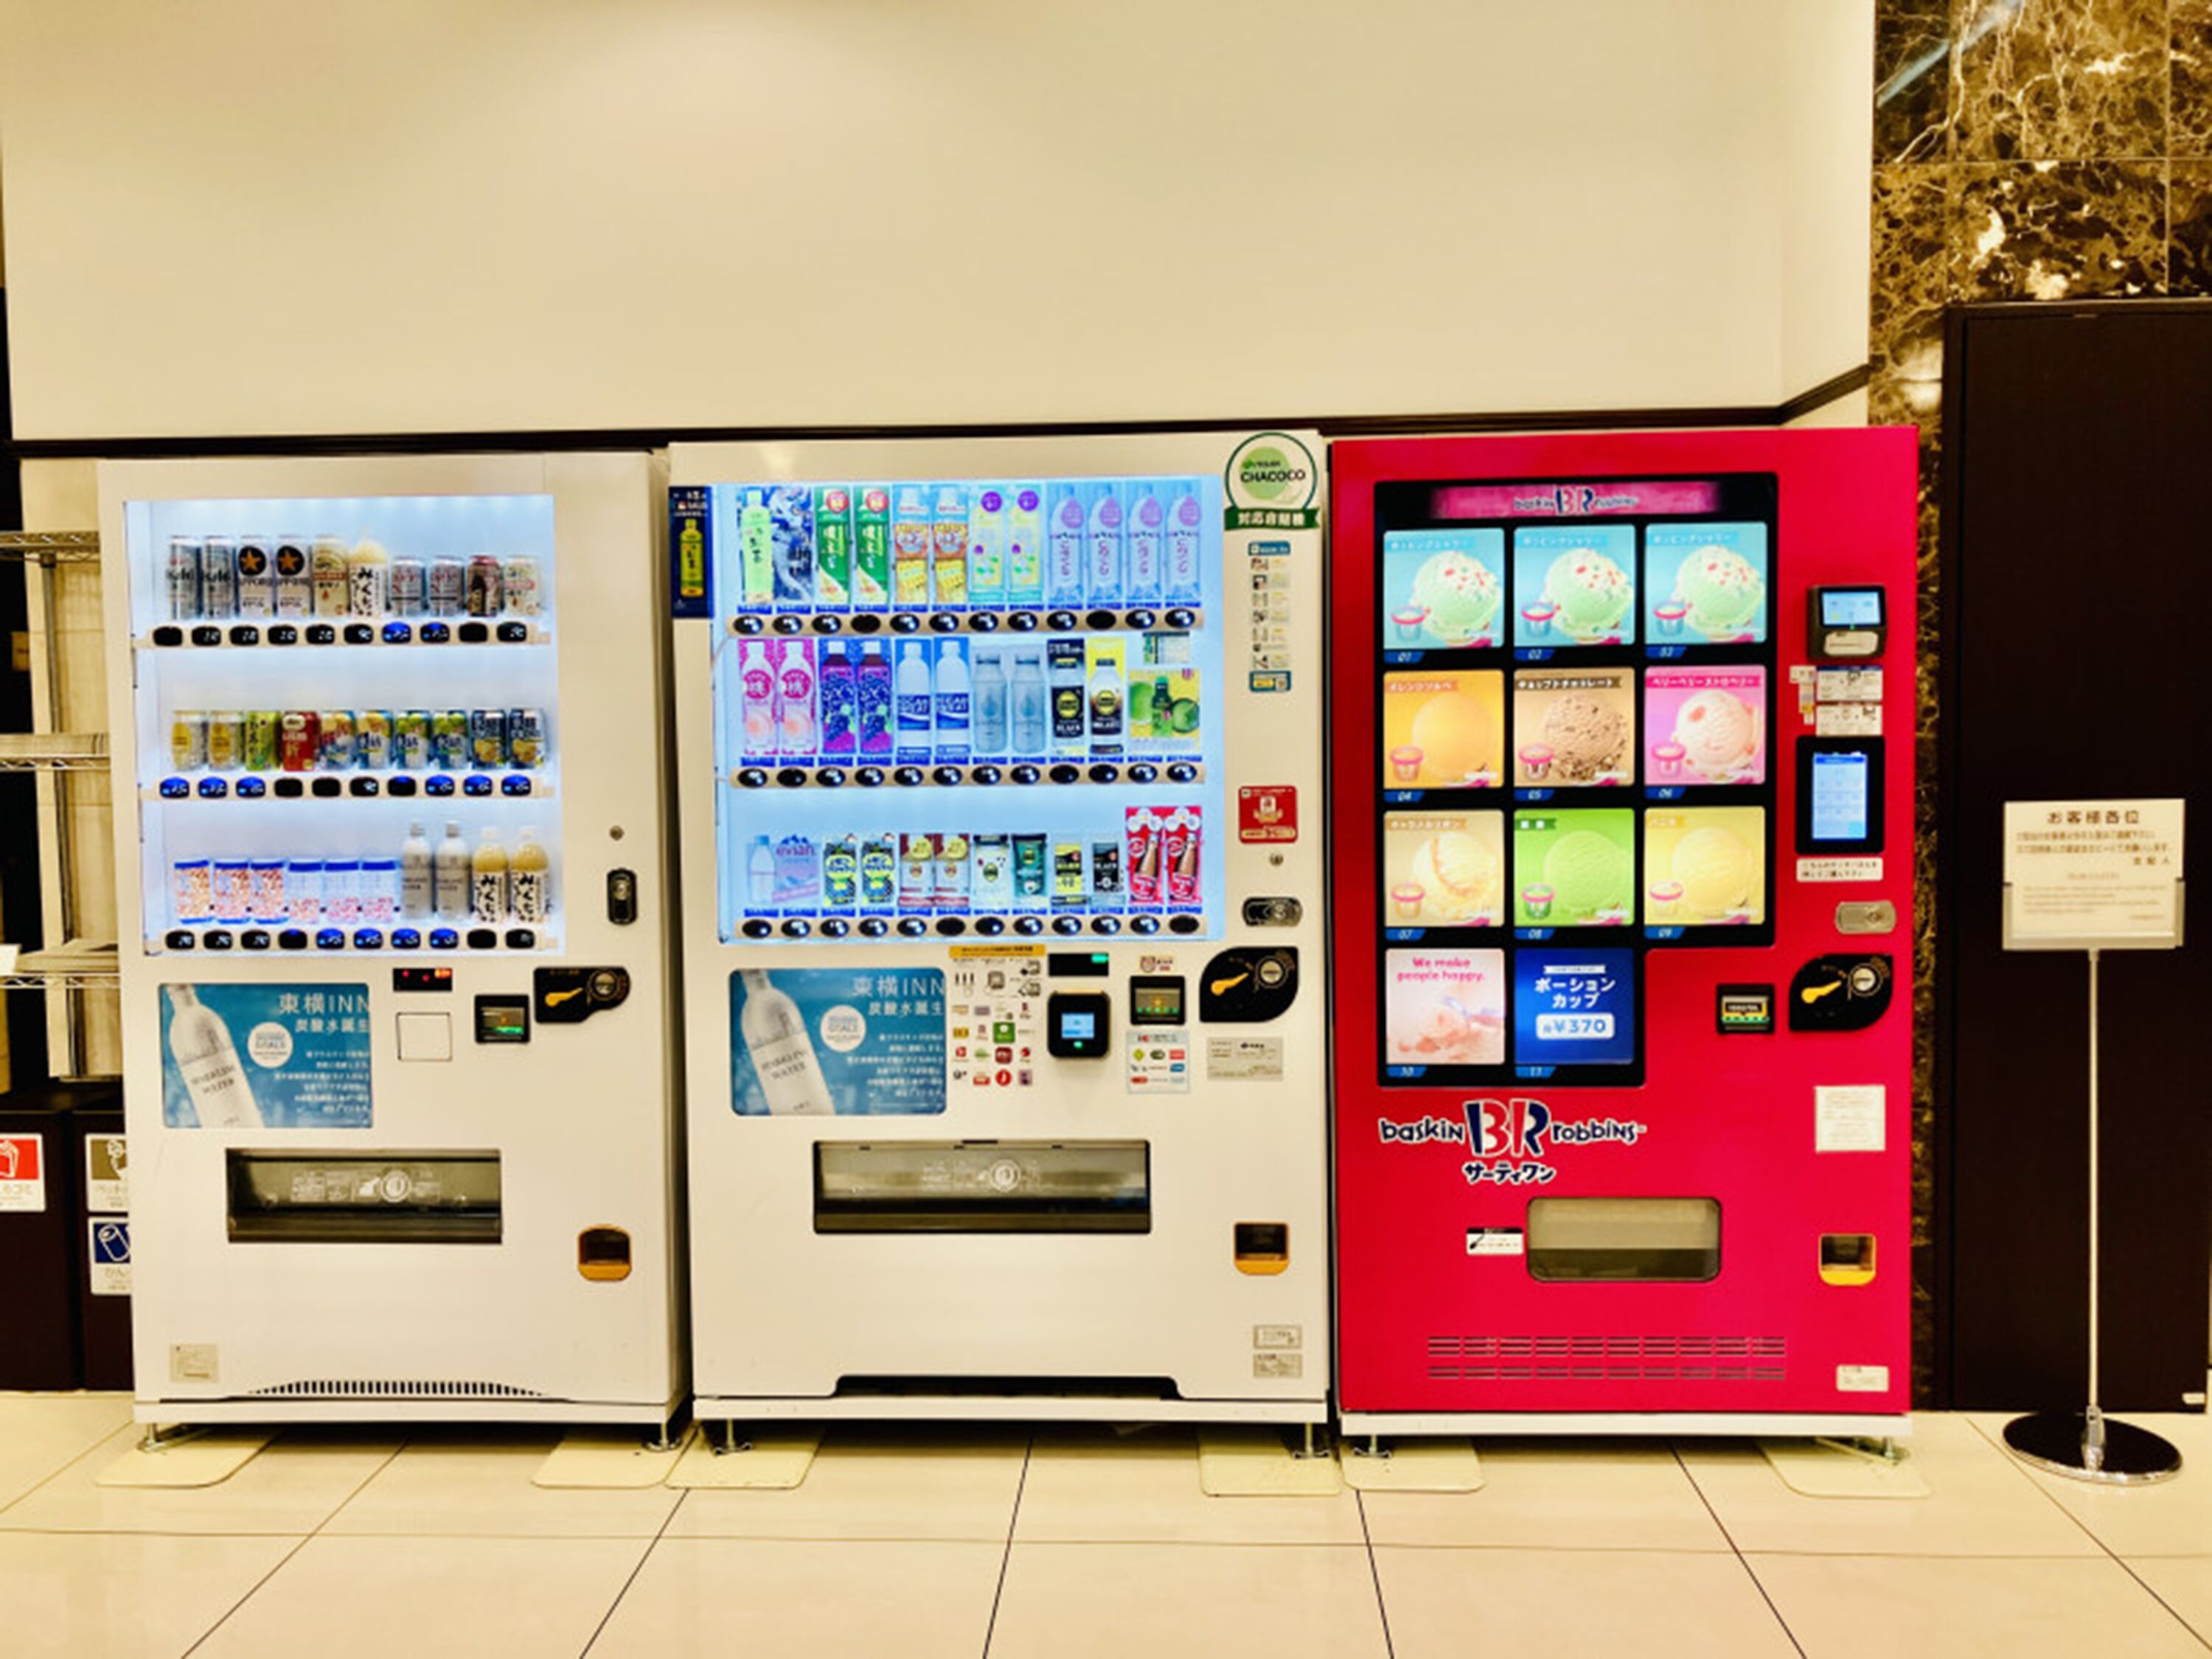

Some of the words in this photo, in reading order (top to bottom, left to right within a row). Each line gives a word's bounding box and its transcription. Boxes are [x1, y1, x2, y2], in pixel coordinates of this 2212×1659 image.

[1240, 469, 1306, 483] CHACOCO
[1553, 486, 1596, 514] BR
[2048, 810, 2140, 825] お客様各位
[1412, 958, 1432, 968] We
[1434, 958, 1471, 967] make
[1397, 970, 1439, 983] people
[1534, 977, 1616, 993] ポーション
[852, 975, 944, 998] 東横INN
[278, 992, 369, 1015] 東横INN
[1552, 992, 1601, 1009] カップ
[1380, 1119, 1464, 1144] baskin
[1465, 1100, 1549, 1155] BR
[1551, 1119, 1637, 1144] robbins
[1463, 1161, 1556, 1183] サーティワン
